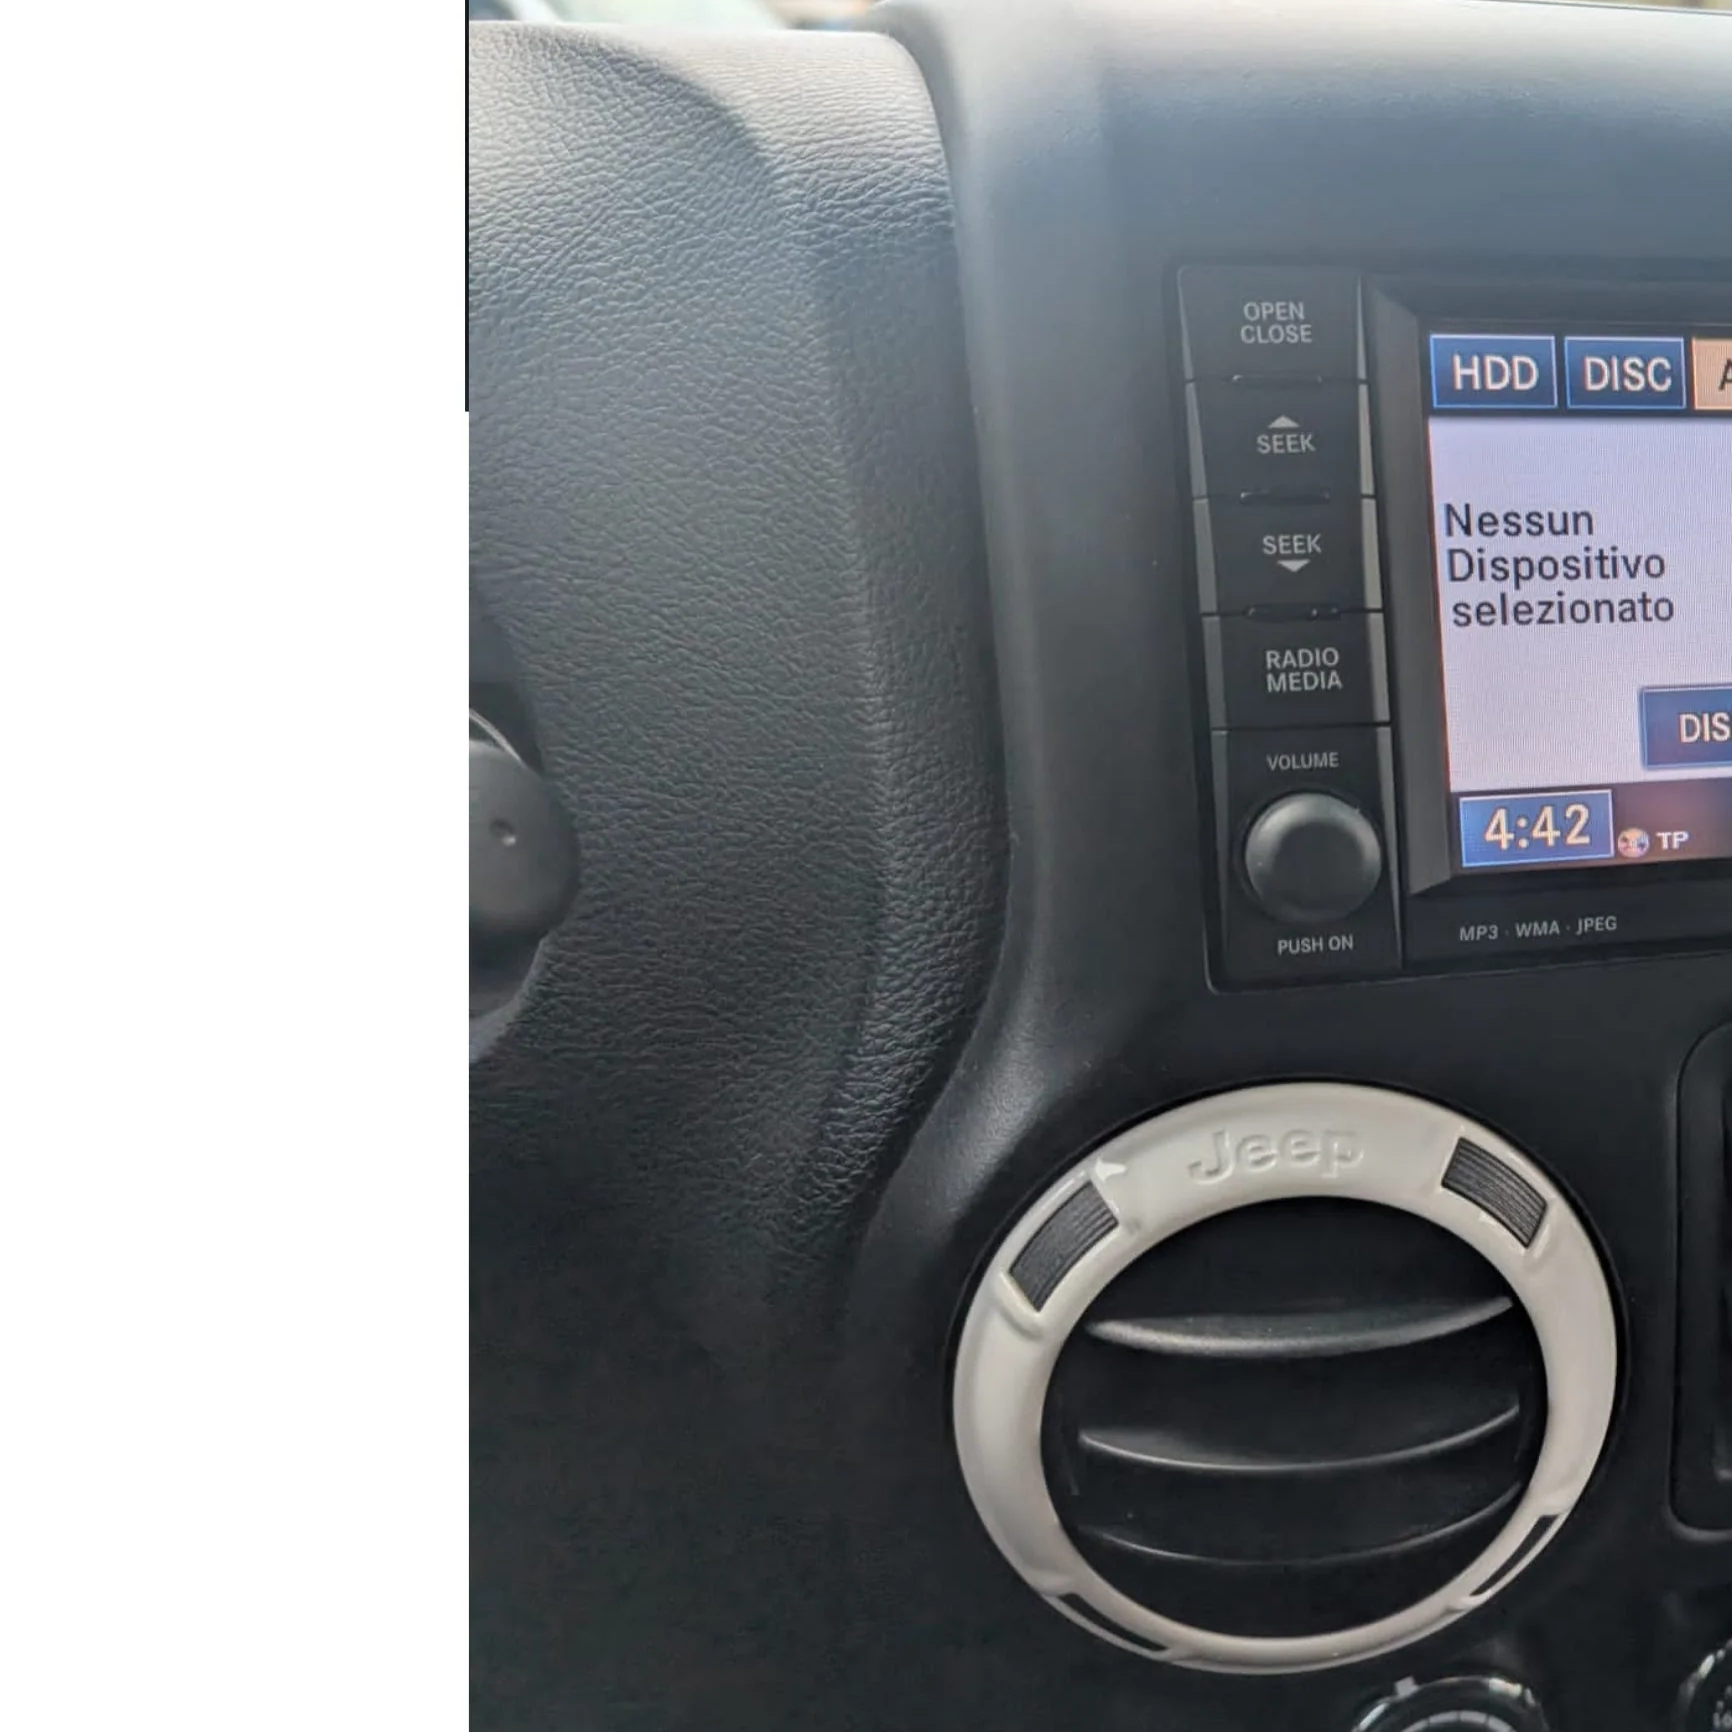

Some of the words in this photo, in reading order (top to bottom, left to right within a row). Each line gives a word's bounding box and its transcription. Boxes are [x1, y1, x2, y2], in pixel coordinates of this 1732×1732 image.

[1243, 301, 1305, 322] OPEN
[1240, 324, 1313, 345] CLOSE
[1451, 355, 1540, 391] HDD
[1583, 356, 1673, 392] DISC
[1256, 433, 1316, 454] SEEK
[1444, 502, 1594, 538] Nessun
[1262, 534, 1322, 555] SEEK
[1446, 547, 1667, 590] Dispositivo
[1451, 591, 1675, 629] selezionato
[1265, 647, 1340, 669] RADIO
[1265, 669, 1343, 692] MEDIA
[1266, 752, 1340, 772] VOLUME
[1483, 803, 1592, 851] 4:42
[1458, 924, 1499, 943] MP3
[1514, 918, 1561, 937] WMA
[1576, 915, 1618, 935] JPEG
[1277, 936, 1325, 956] PUSH
[1328, 935, 1355, 954] ON
[1187, 1129, 1365, 1185] Jeep
